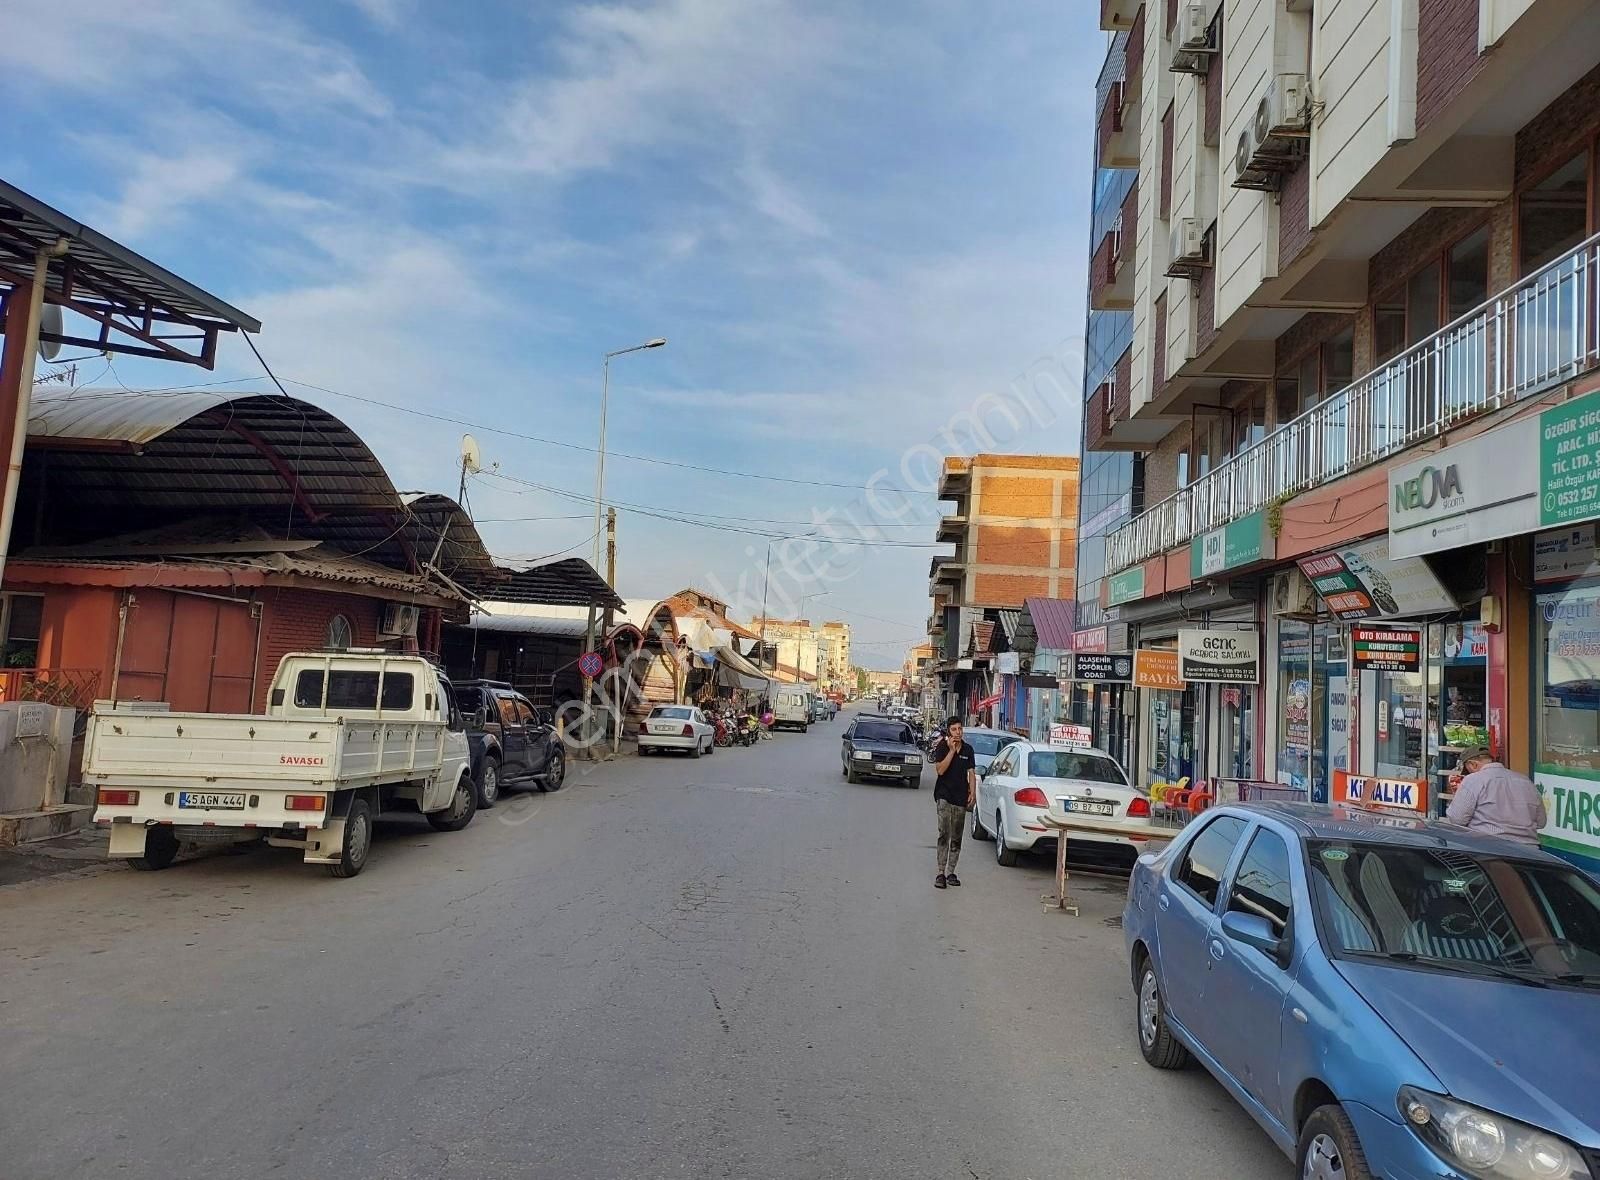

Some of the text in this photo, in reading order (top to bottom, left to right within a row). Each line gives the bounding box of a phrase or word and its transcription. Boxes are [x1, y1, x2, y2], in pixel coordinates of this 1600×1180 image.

[1544, 414, 1577, 440] ÖZGÜR
[1587, 426, 1600, 446] Hİ
[1551, 457, 1570, 476] TİC.
[1571, 454, 1593, 472] LTD.
[1394, 463, 1463, 514] NEOVA
[1547, 477, 1564, 491] Halit
[1557, 485, 1598, 507] 0532 257
[1206, 535, 1221, 557] HDI
[1203, 637, 1237, 650] GENÇ
[1360, 631, 1413, 642] OTO KIRALAMA
[1367, 651, 1406, 661] KURU KAHVE
[1084, 671, 1106, 679] ODASI
[1139, 671, 1182, 685] BAYİS
[1050, 731, 1090, 741] KIRALAMA
[1062, 726, 1078, 734] OTO
[185, 793, 243, 807] 45 AGN 444
[1069, 801, 1079, 810] 09
[1082, 802, 1092, 811] BZ
